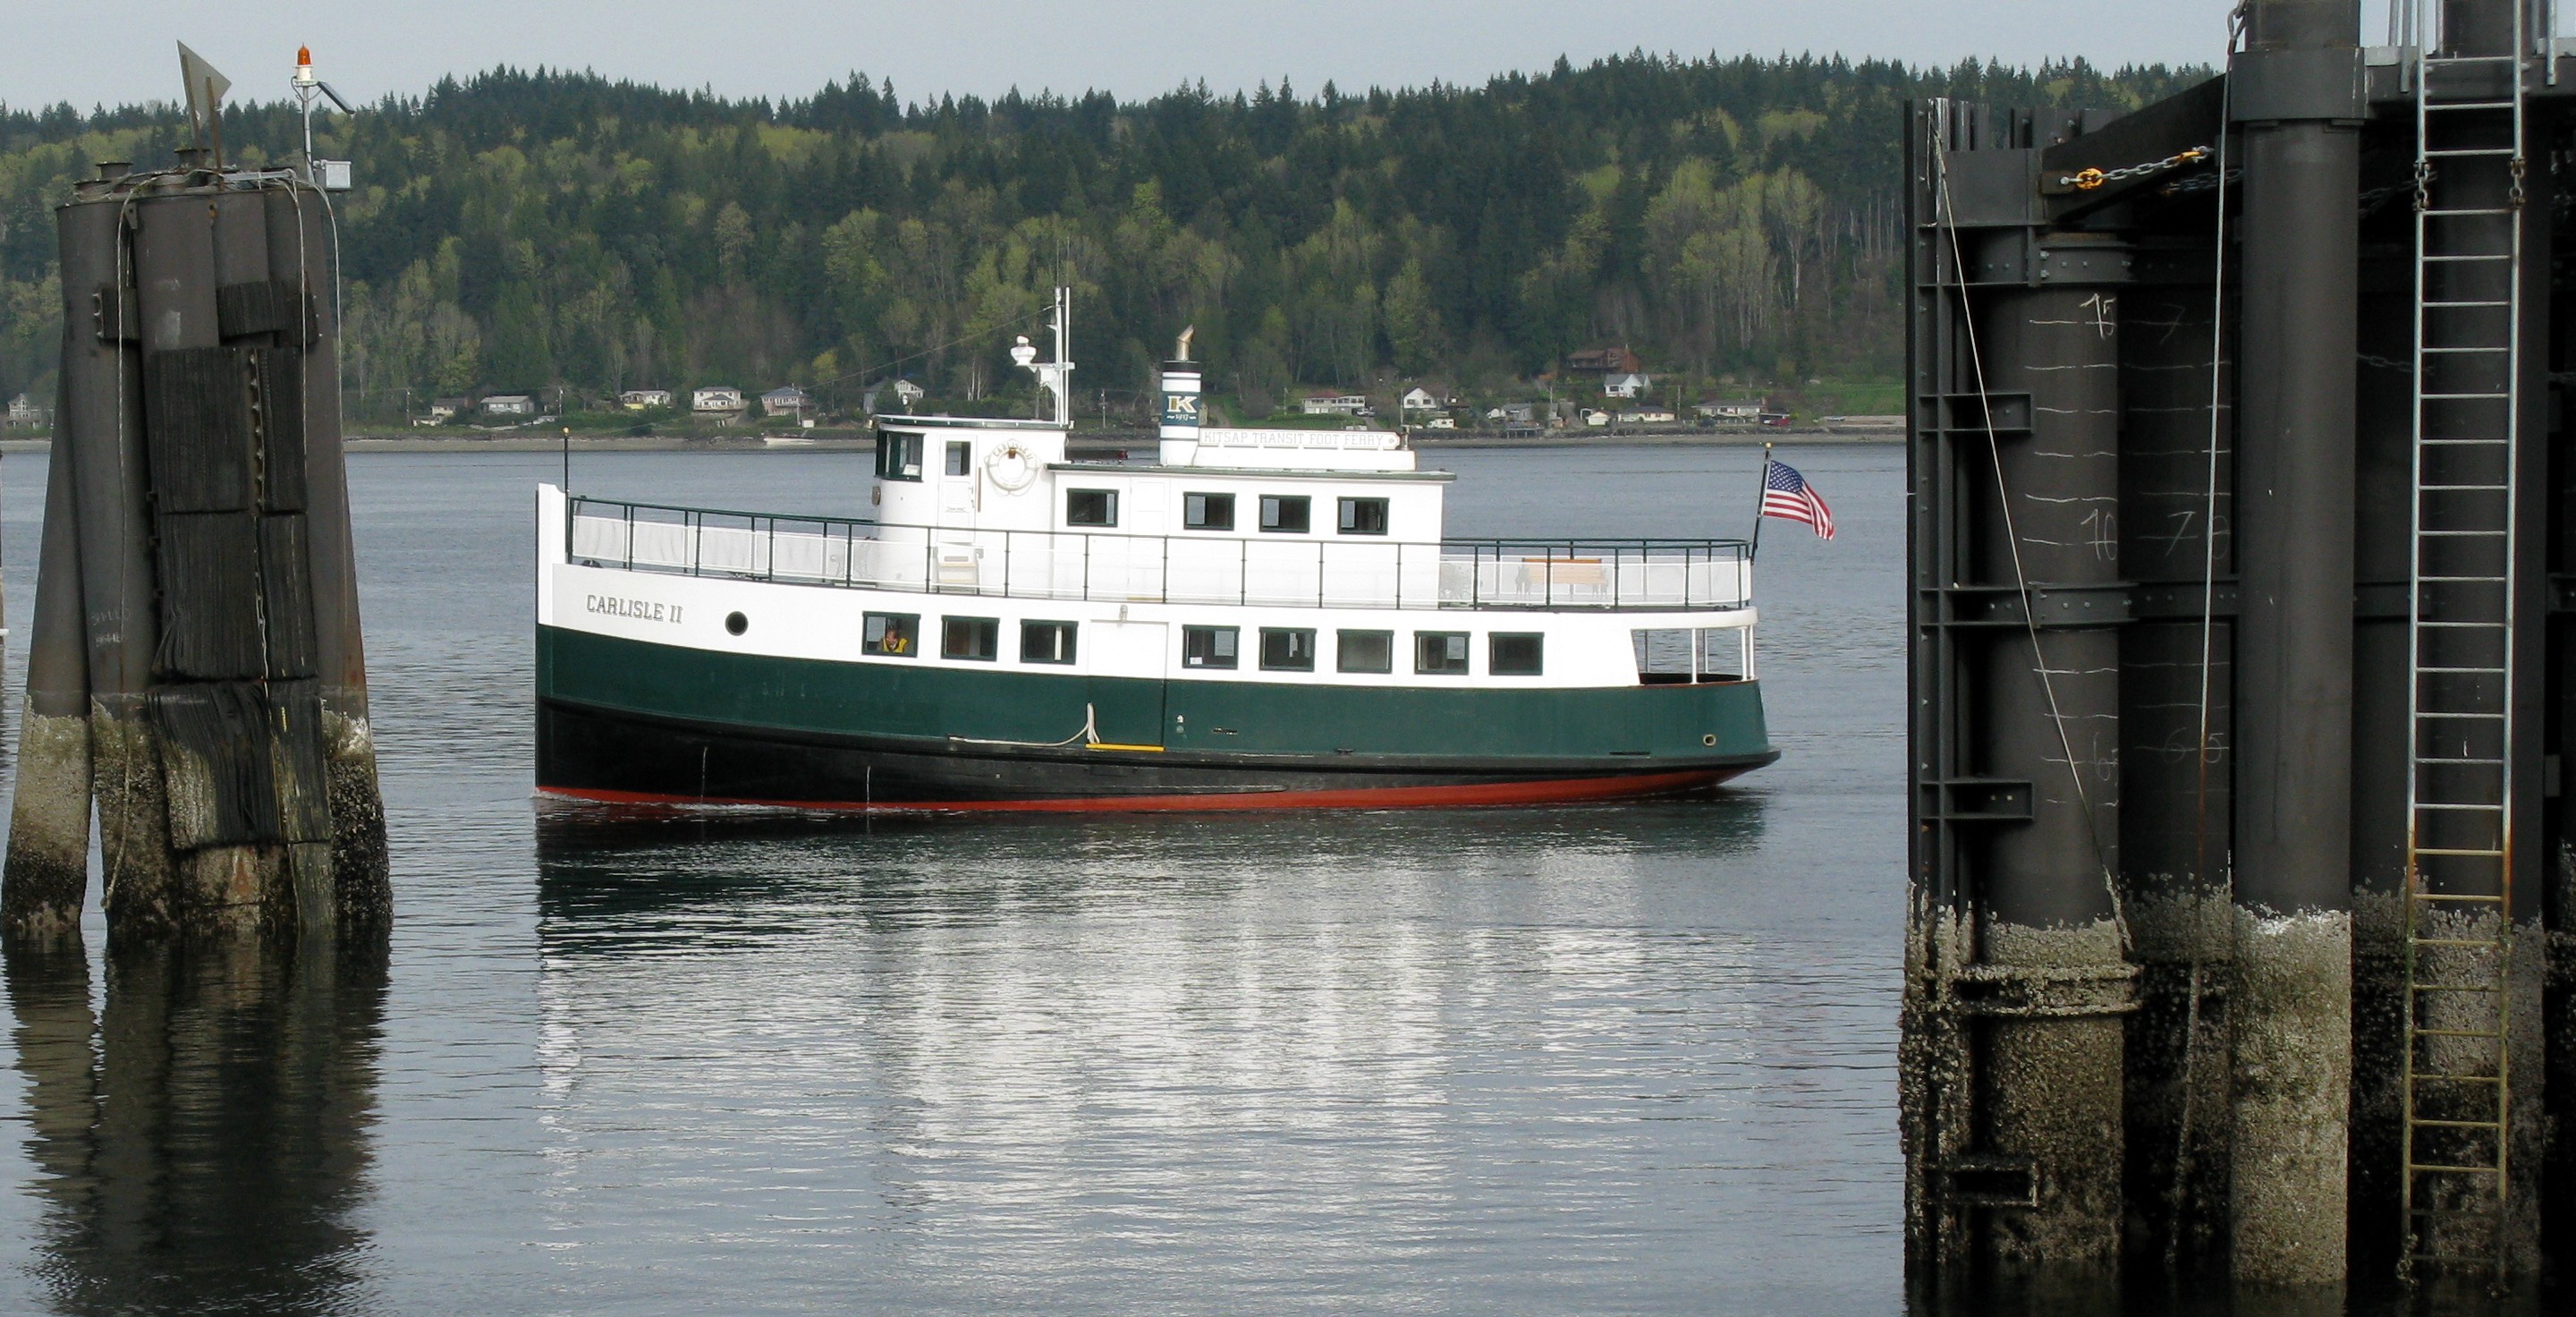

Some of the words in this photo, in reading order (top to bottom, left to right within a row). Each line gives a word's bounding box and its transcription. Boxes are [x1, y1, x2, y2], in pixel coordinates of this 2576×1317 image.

[1166, 395, 1198, 413] K
[1203, 430, 1249, 445] KITSAP
[1252, 432, 1304, 446] TRANSIT
[1309, 433, 1340, 446] FOOT
[1344, 435, 1384, 447] FERRY
[586, 594, 665, 622] CARLISLE
[669, 605, 683, 624] II
